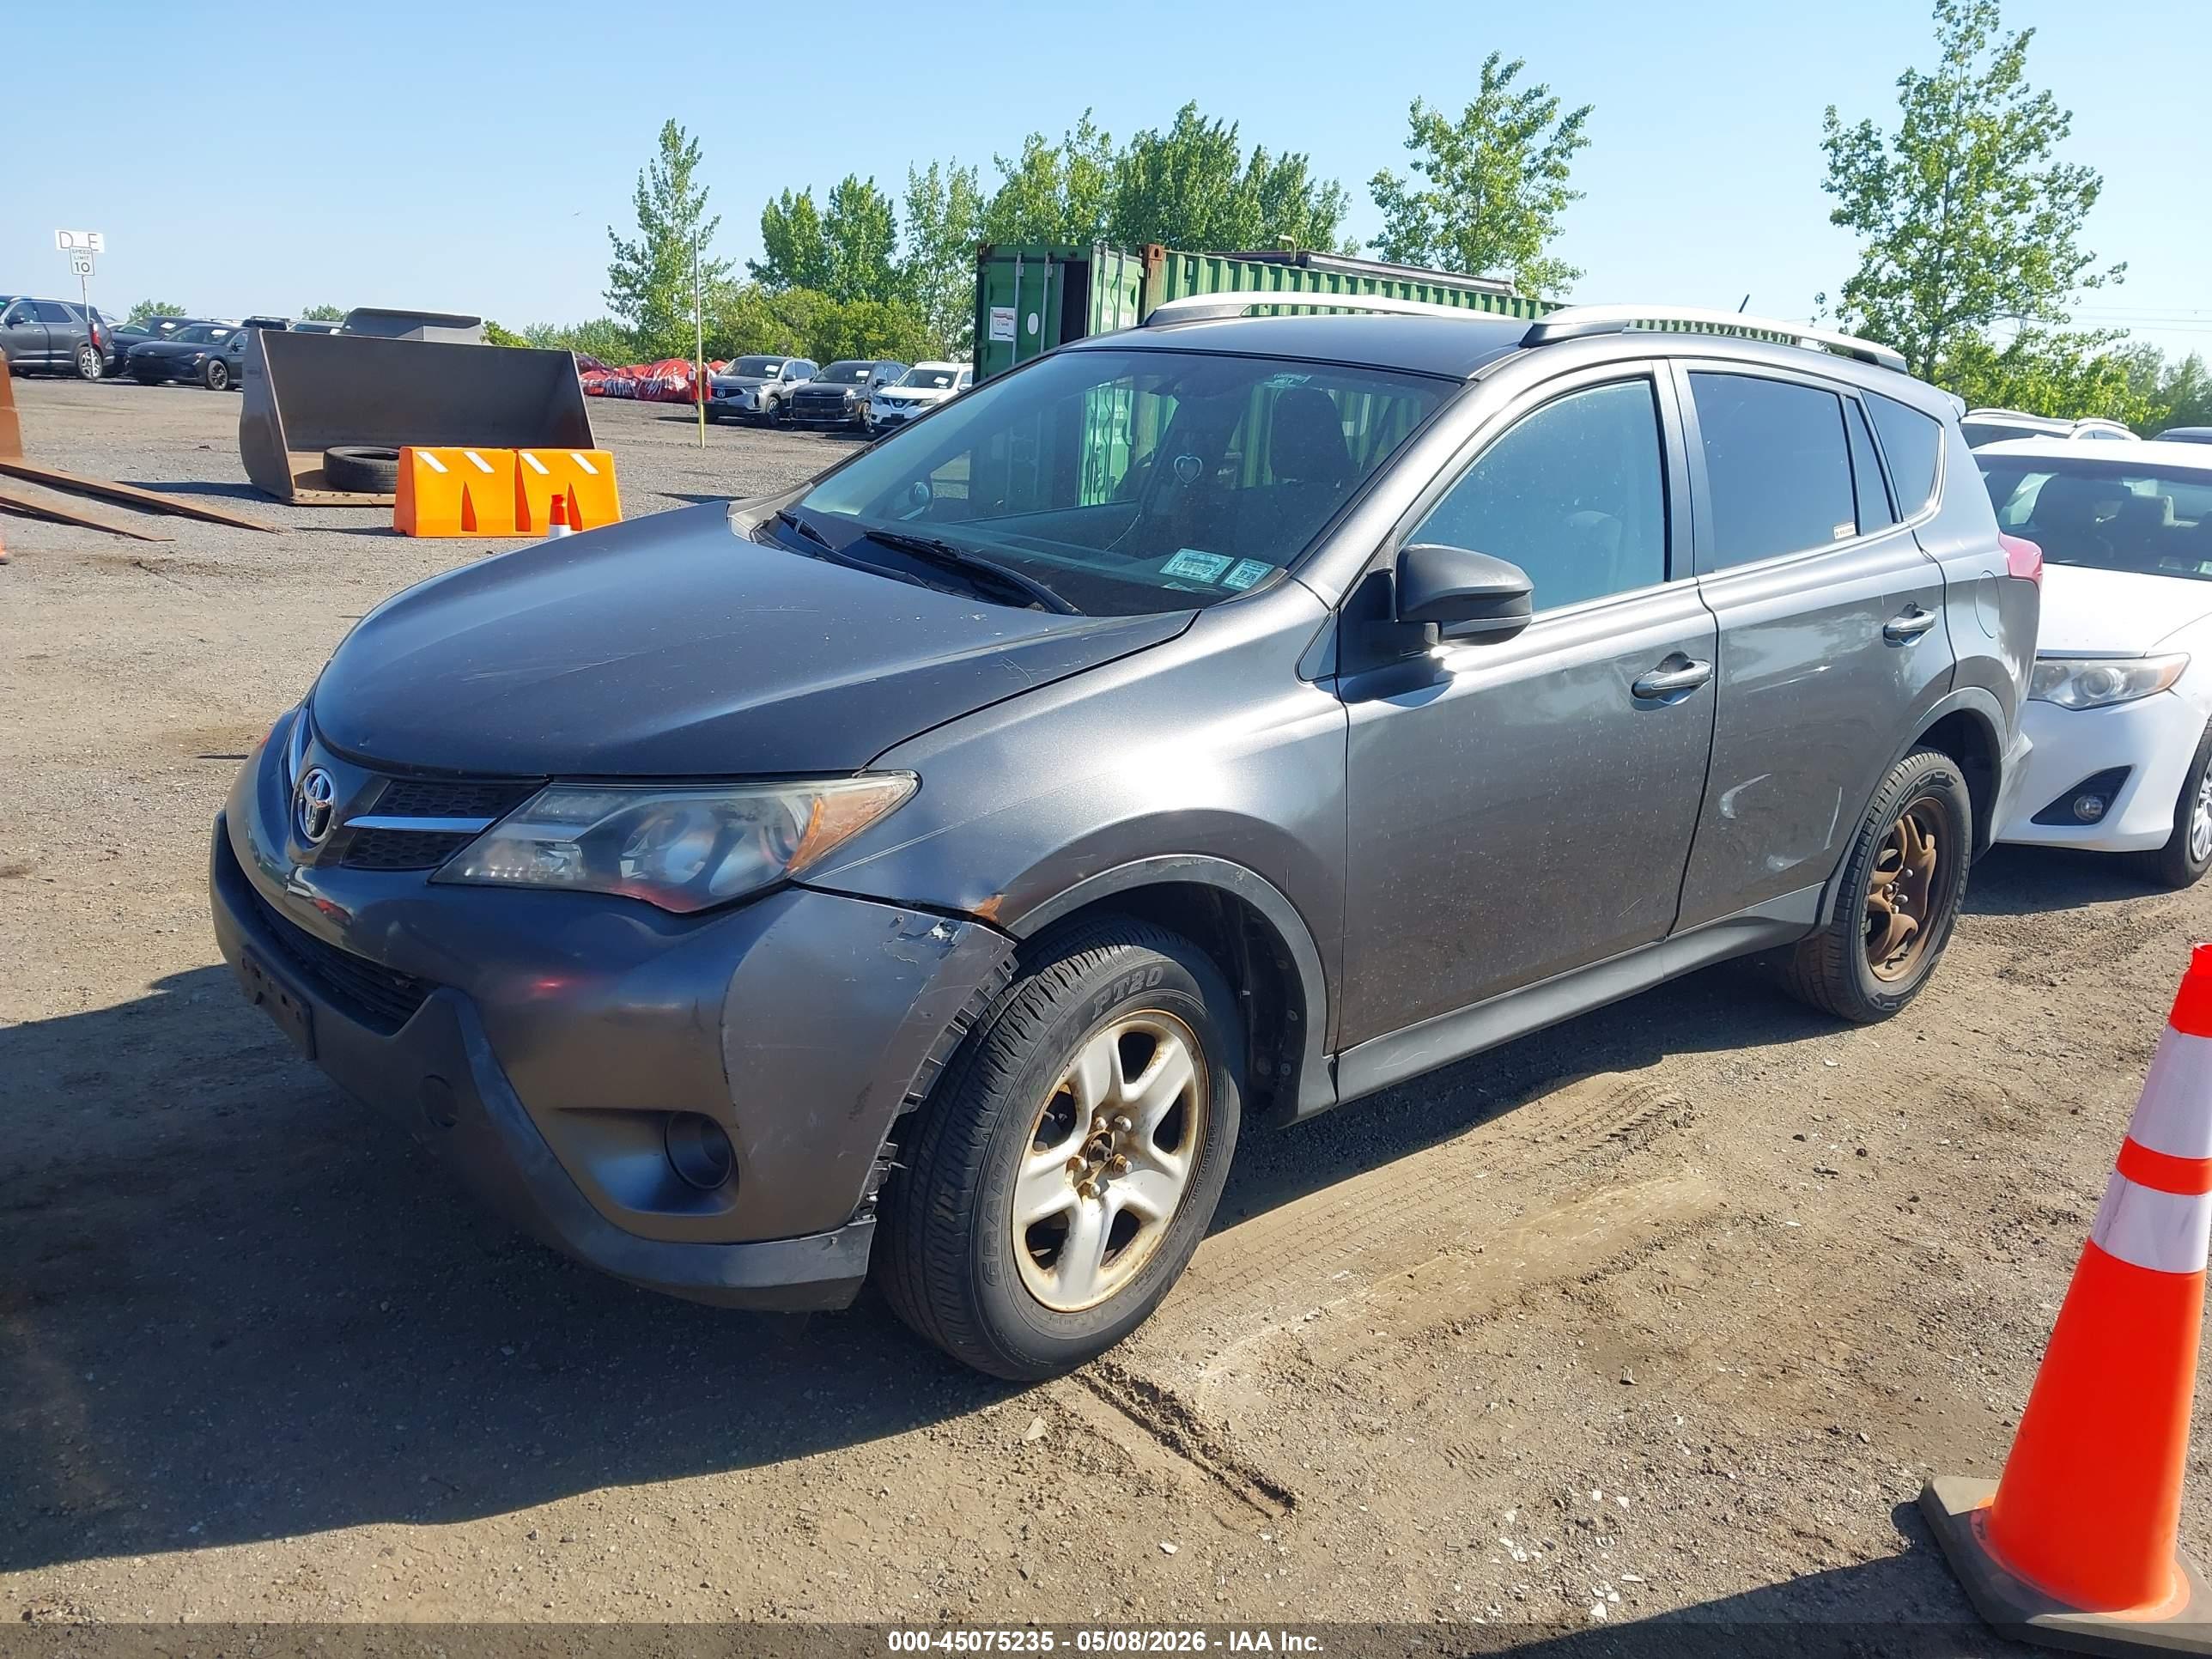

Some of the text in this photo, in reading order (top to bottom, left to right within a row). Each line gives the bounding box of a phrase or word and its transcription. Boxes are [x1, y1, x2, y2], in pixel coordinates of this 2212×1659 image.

[58, 231, 100, 252] D E
[75, 262, 90, 272] 10
[1091, 966, 1164, 1021] PT20
